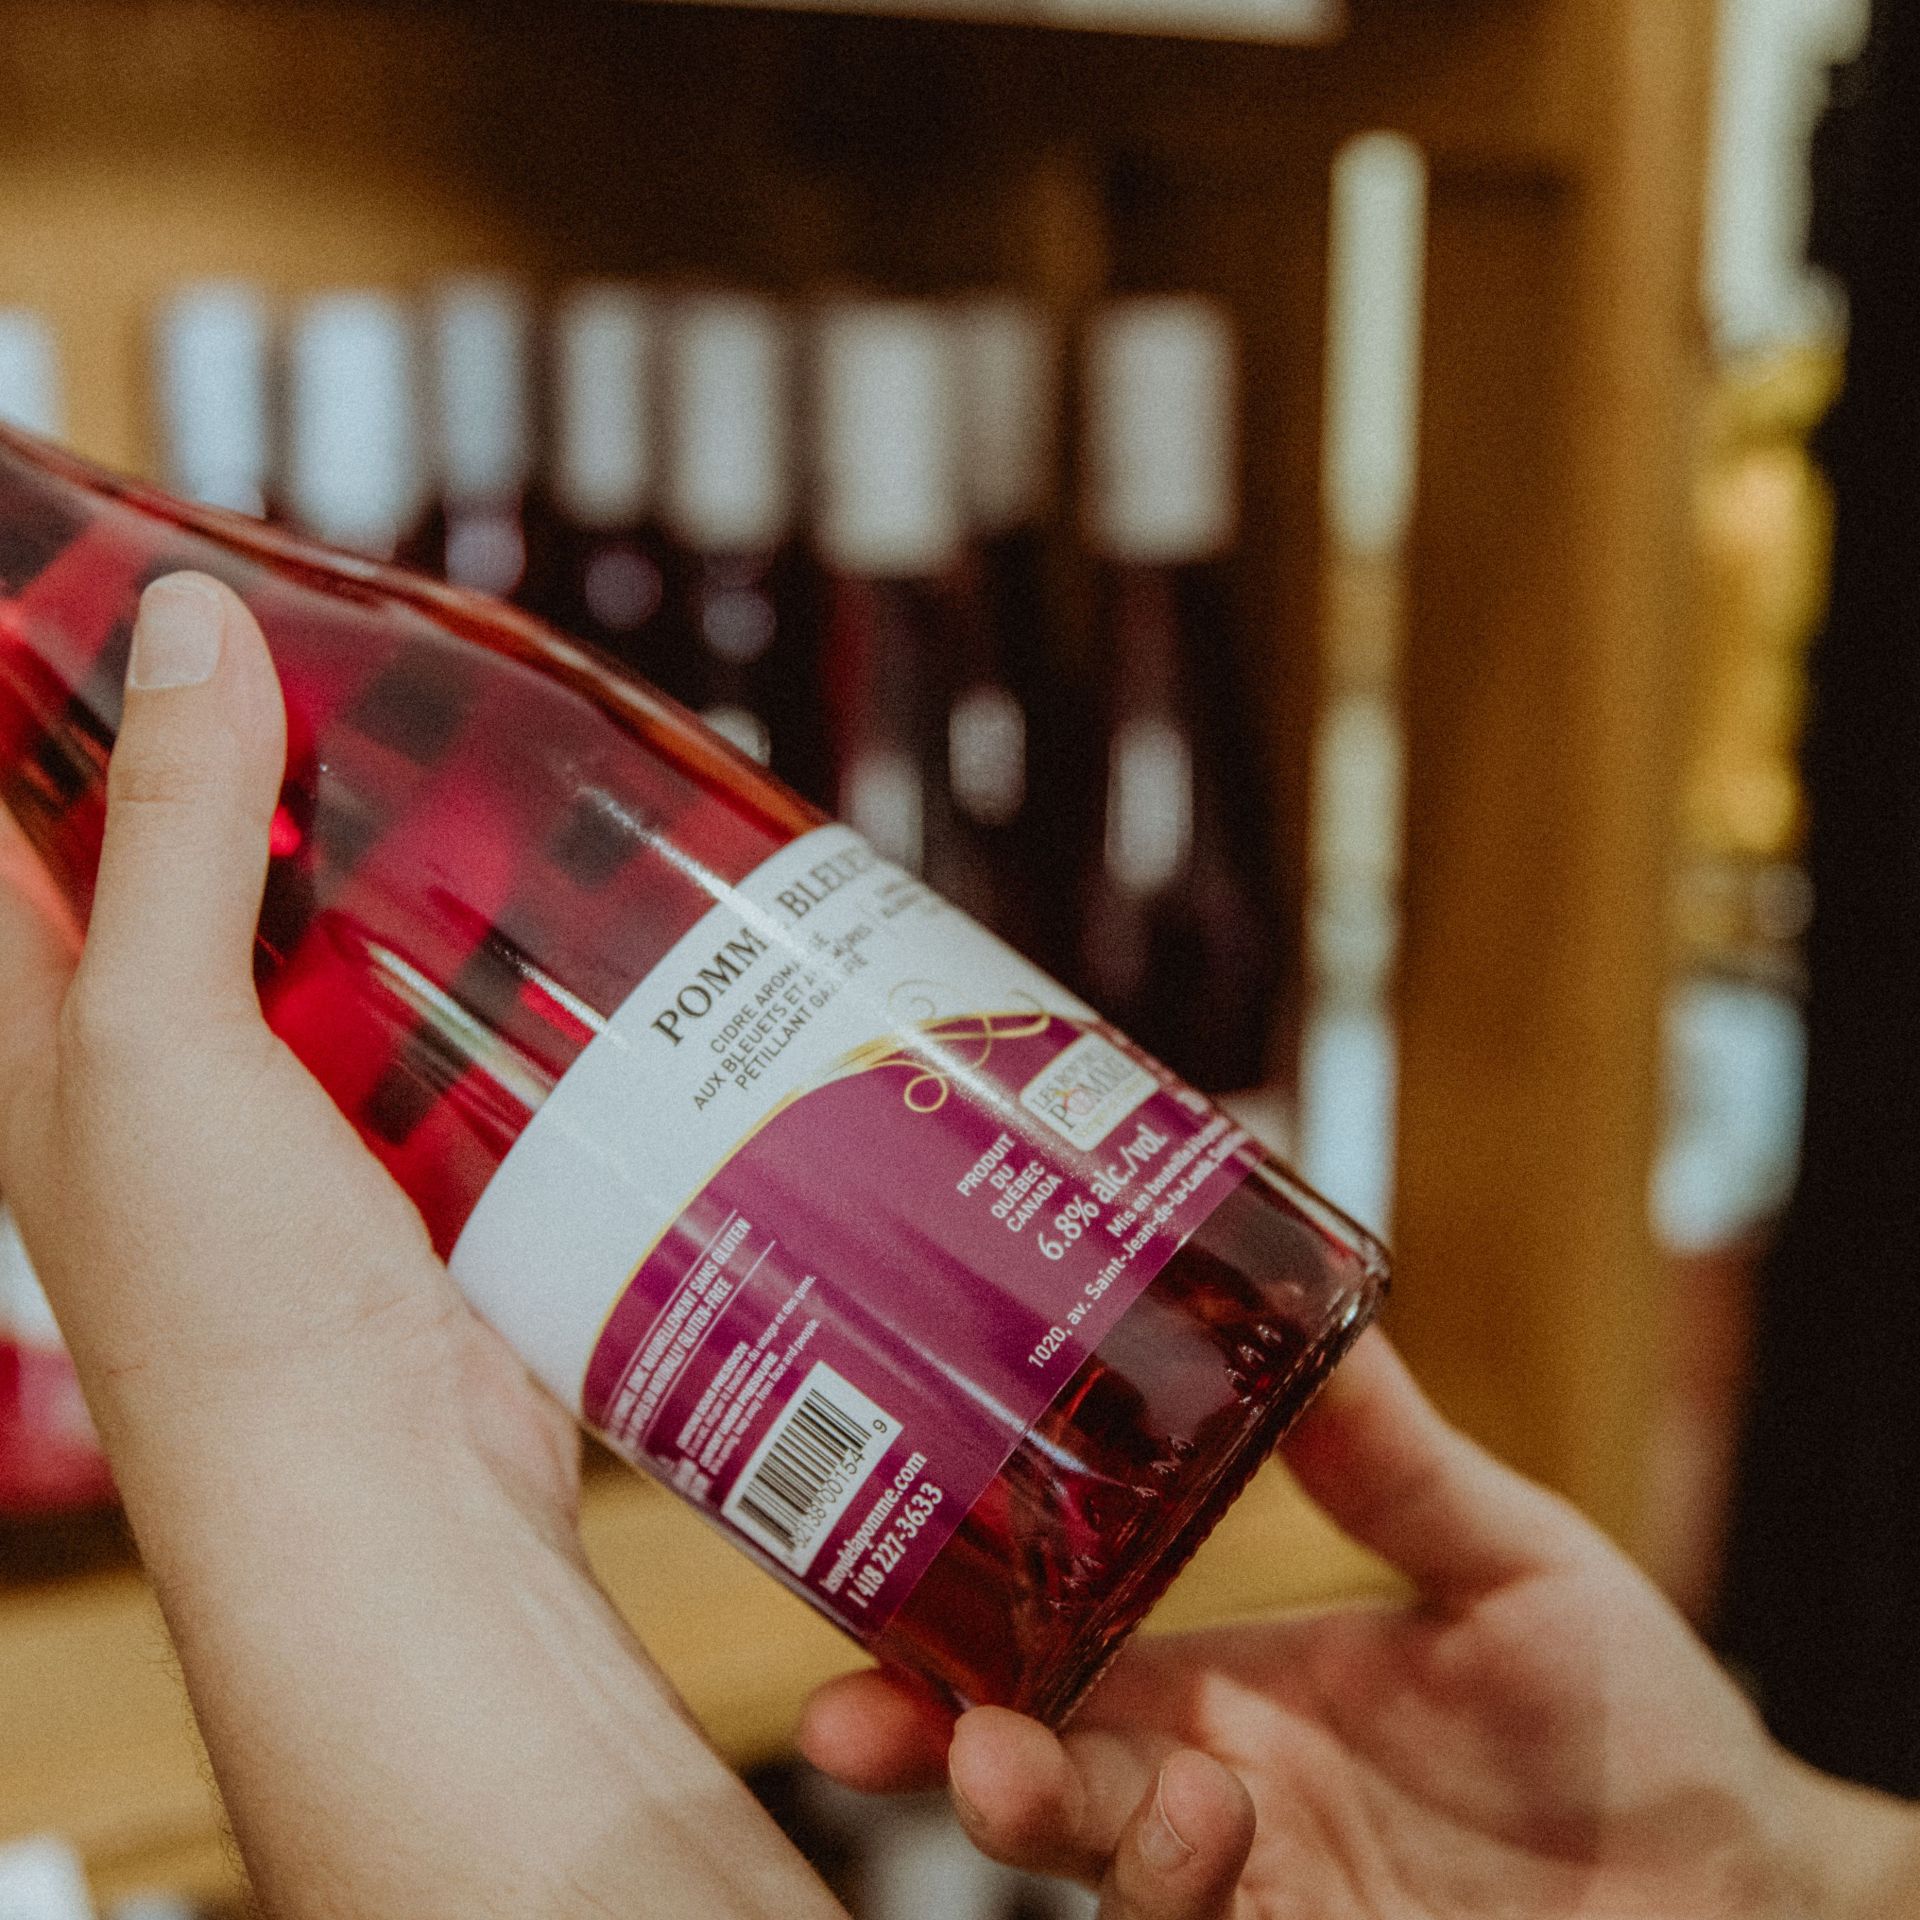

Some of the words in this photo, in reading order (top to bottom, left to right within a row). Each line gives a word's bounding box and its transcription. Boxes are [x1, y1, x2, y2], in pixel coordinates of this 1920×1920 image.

[649, 913, 778, 1048] POMM
[691, 1070, 726, 1110] AUX
[720, 1002, 788, 1073] BLEUETS
[784, 981, 806, 1004] ET
[709, 1003, 758, 1054] CIDRE
[732, 1004, 814, 1090] PÉTILLANT
[956, 1132, 1015, 1198] PRODUIT
[988, 1158, 1045, 1221] QUÉBEC
[989, 1163, 1015, 1190] DU
[1005, 1170, 1062, 1234] CANADA
[1032, 1189, 1102, 1264] 6.8%
[1083, 1118, 1169, 1205] alc./vol.
[1106, 1206, 1137, 1238] Mis
[1131, 1190, 1153, 1213] en
[638, 1289, 698, 1369] NATURELLEMENT
[690, 1261, 719, 1294] SANS
[711, 1216, 752, 1265] GLUTEN
[746, 1347, 759, 1361] du
[755, 1321, 780, 1351] visage
[774, 1312, 786, 1324] et
[781, 1297, 797, 1314] des
[793, 1271, 818, 1299] gens.
[646, 1341, 686, 1393] NATURALLY
[675, 1276, 732, 1348] GLUTEN-FREE
[710, 1339, 750, 1392] PRESSION
[756, 1379, 773, 1400] from
[769, 1361, 786, 1381] face
[781, 1346, 797, 1365] and
[793, 1316, 822, 1350] people.
[1026, 1319, 1074, 1372] 1020,
[1066, 1298, 1091, 1325] av.
[737, 1351, 778, 1405] PRESSURE
[819, 1446, 866, 1503] 00154
[871, 1418, 888, 1434] 9
[868, 1479, 945, 1572] 227-3633
[845, 1588, 868, 1607] 1
[850, 1563, 886, 1599] 418
